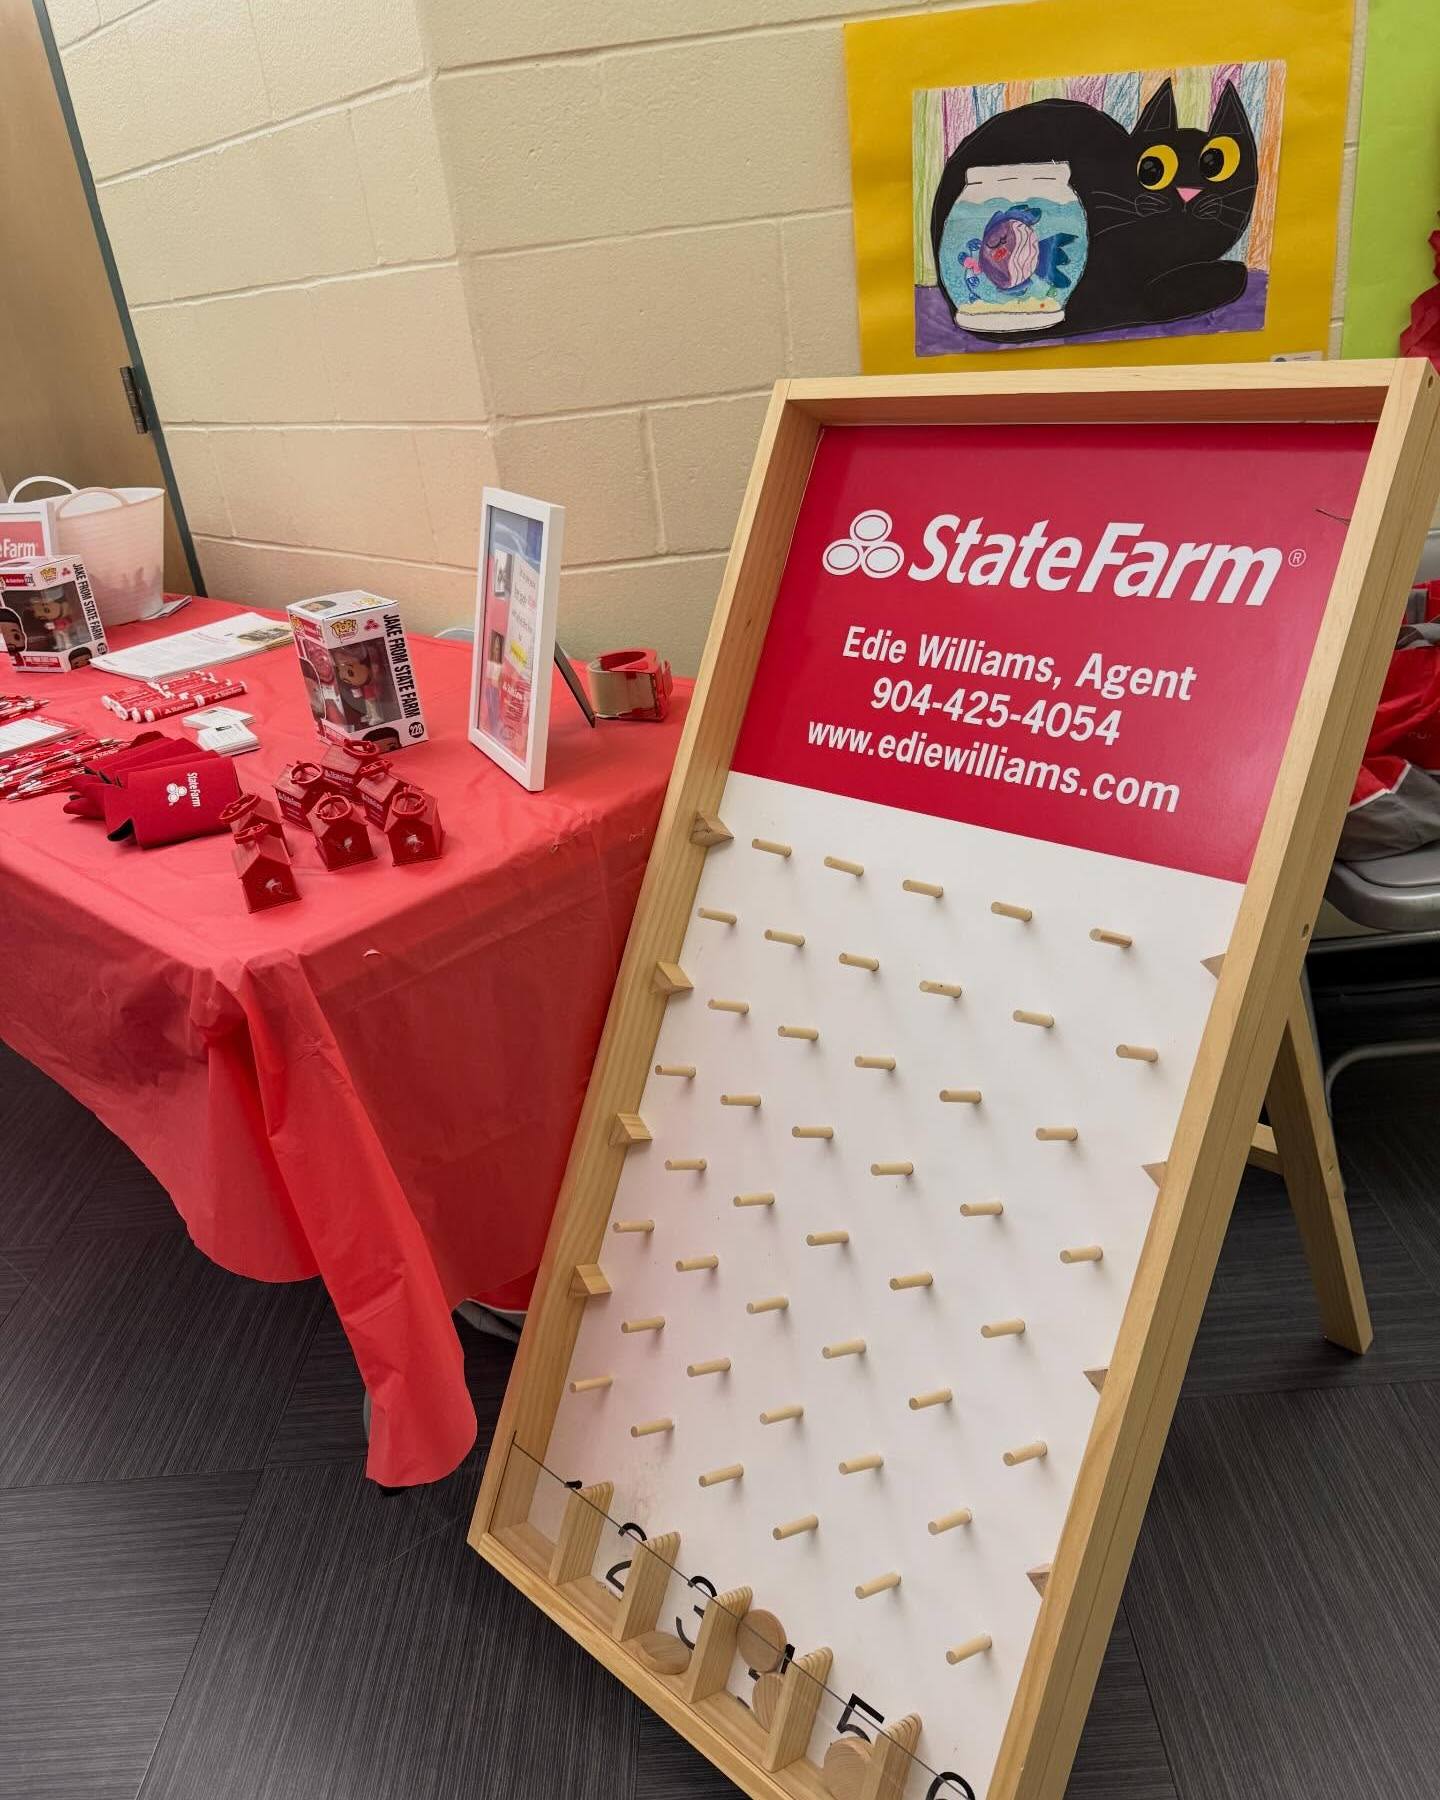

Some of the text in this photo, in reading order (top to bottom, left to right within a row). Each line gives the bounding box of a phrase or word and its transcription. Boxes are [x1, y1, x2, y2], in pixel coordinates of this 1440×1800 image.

[0, 538, 36, 558] Farm
[73, 563, 87, 581] JAKE
[78, 580, 92, 601] FROM
[84, 600, 98, 621] STATE
[90, 620, 104, 641] FARM
[383, 614, 421, 719] JAKE FROM STATE FARM
[842, 625, 1197, 702] Edie Williams, Agent
[870, 677, 1122, 746] 904-425-4054
[808, 721, 1180, 813] www.ediewilliams.com
